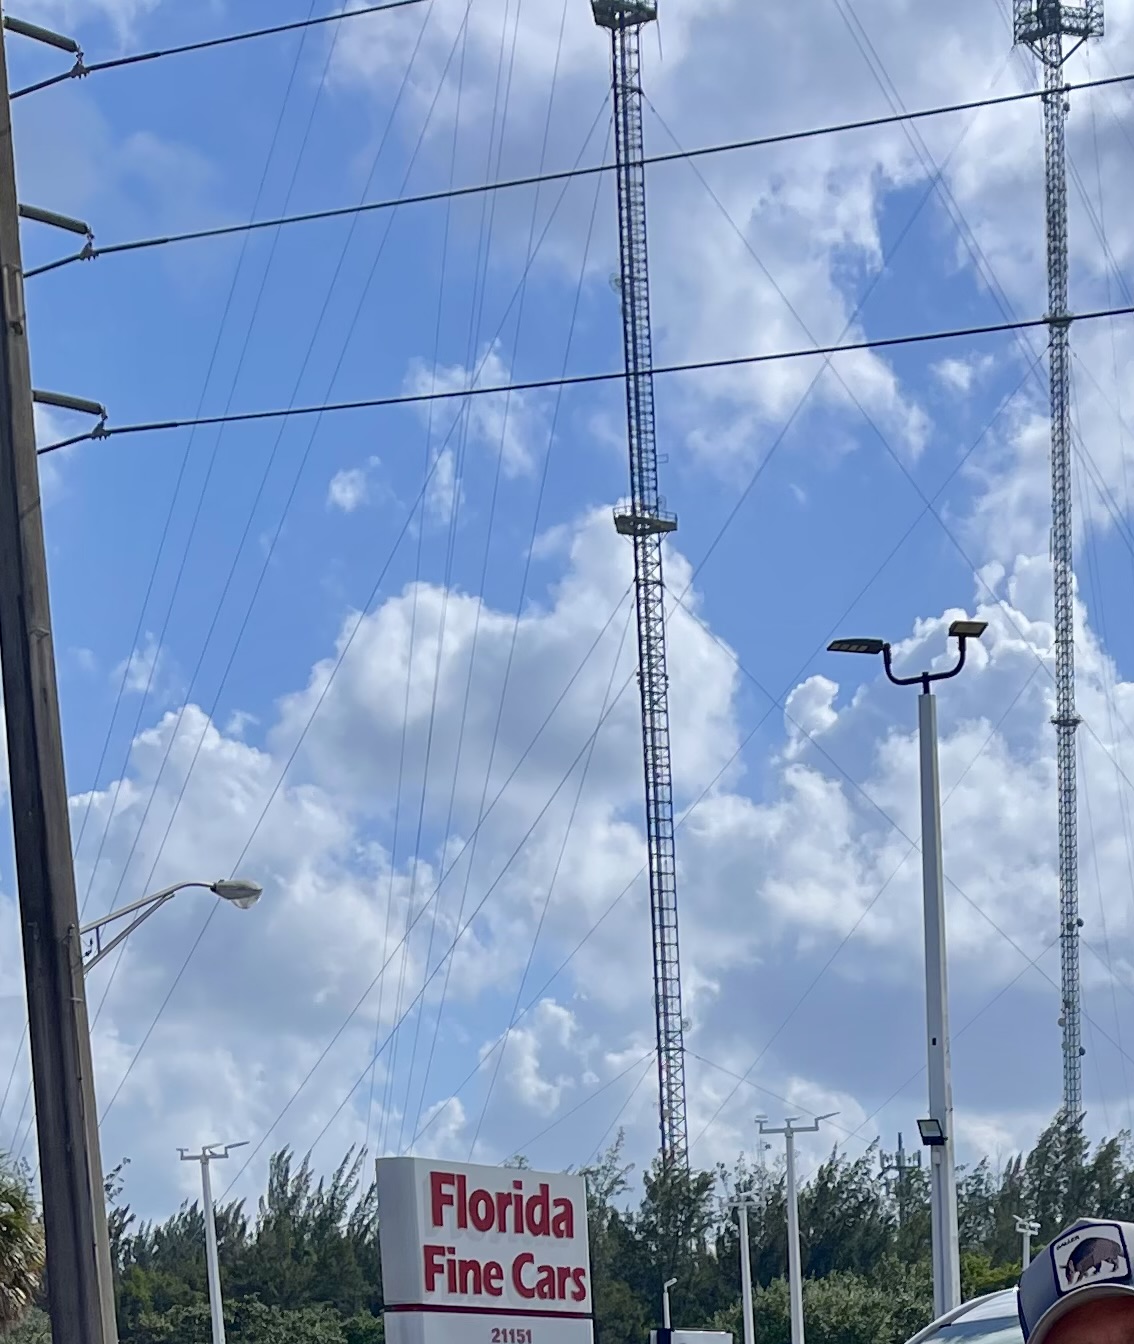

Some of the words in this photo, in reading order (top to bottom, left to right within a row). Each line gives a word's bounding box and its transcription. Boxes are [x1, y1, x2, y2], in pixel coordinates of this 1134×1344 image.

[430, 1171, 575, 1239] Florida
[423, 1245, 504, 1296] Fine
[512, 1252, 587, 1301] Cars
[491, 1327, 532, 1344] 21151
